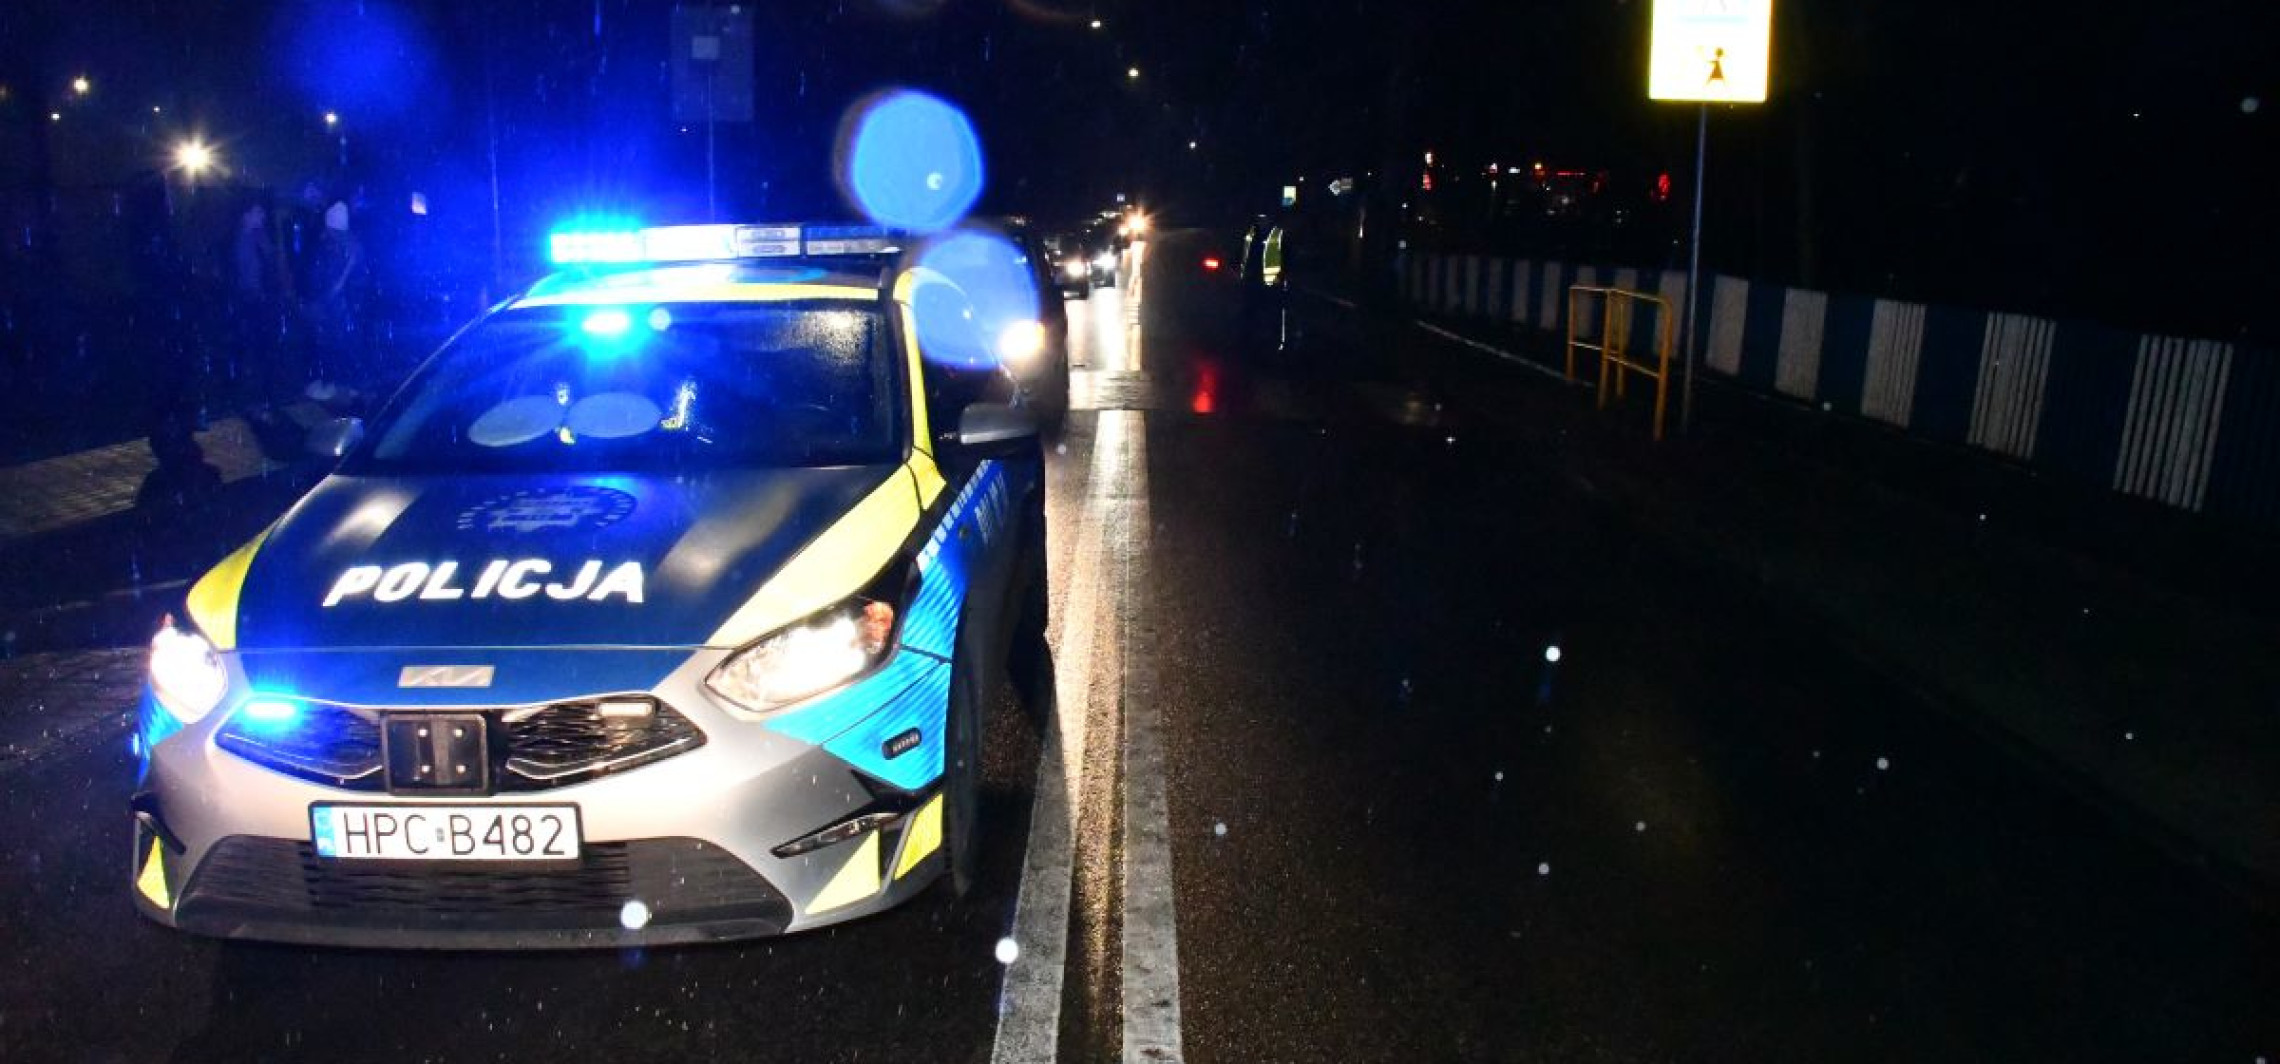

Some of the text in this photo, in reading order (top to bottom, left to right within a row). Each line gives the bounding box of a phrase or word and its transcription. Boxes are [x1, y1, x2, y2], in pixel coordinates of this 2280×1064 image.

[322, 558, 645, 607] POLICJA
[343, 812, 565, 855] HPC B482
